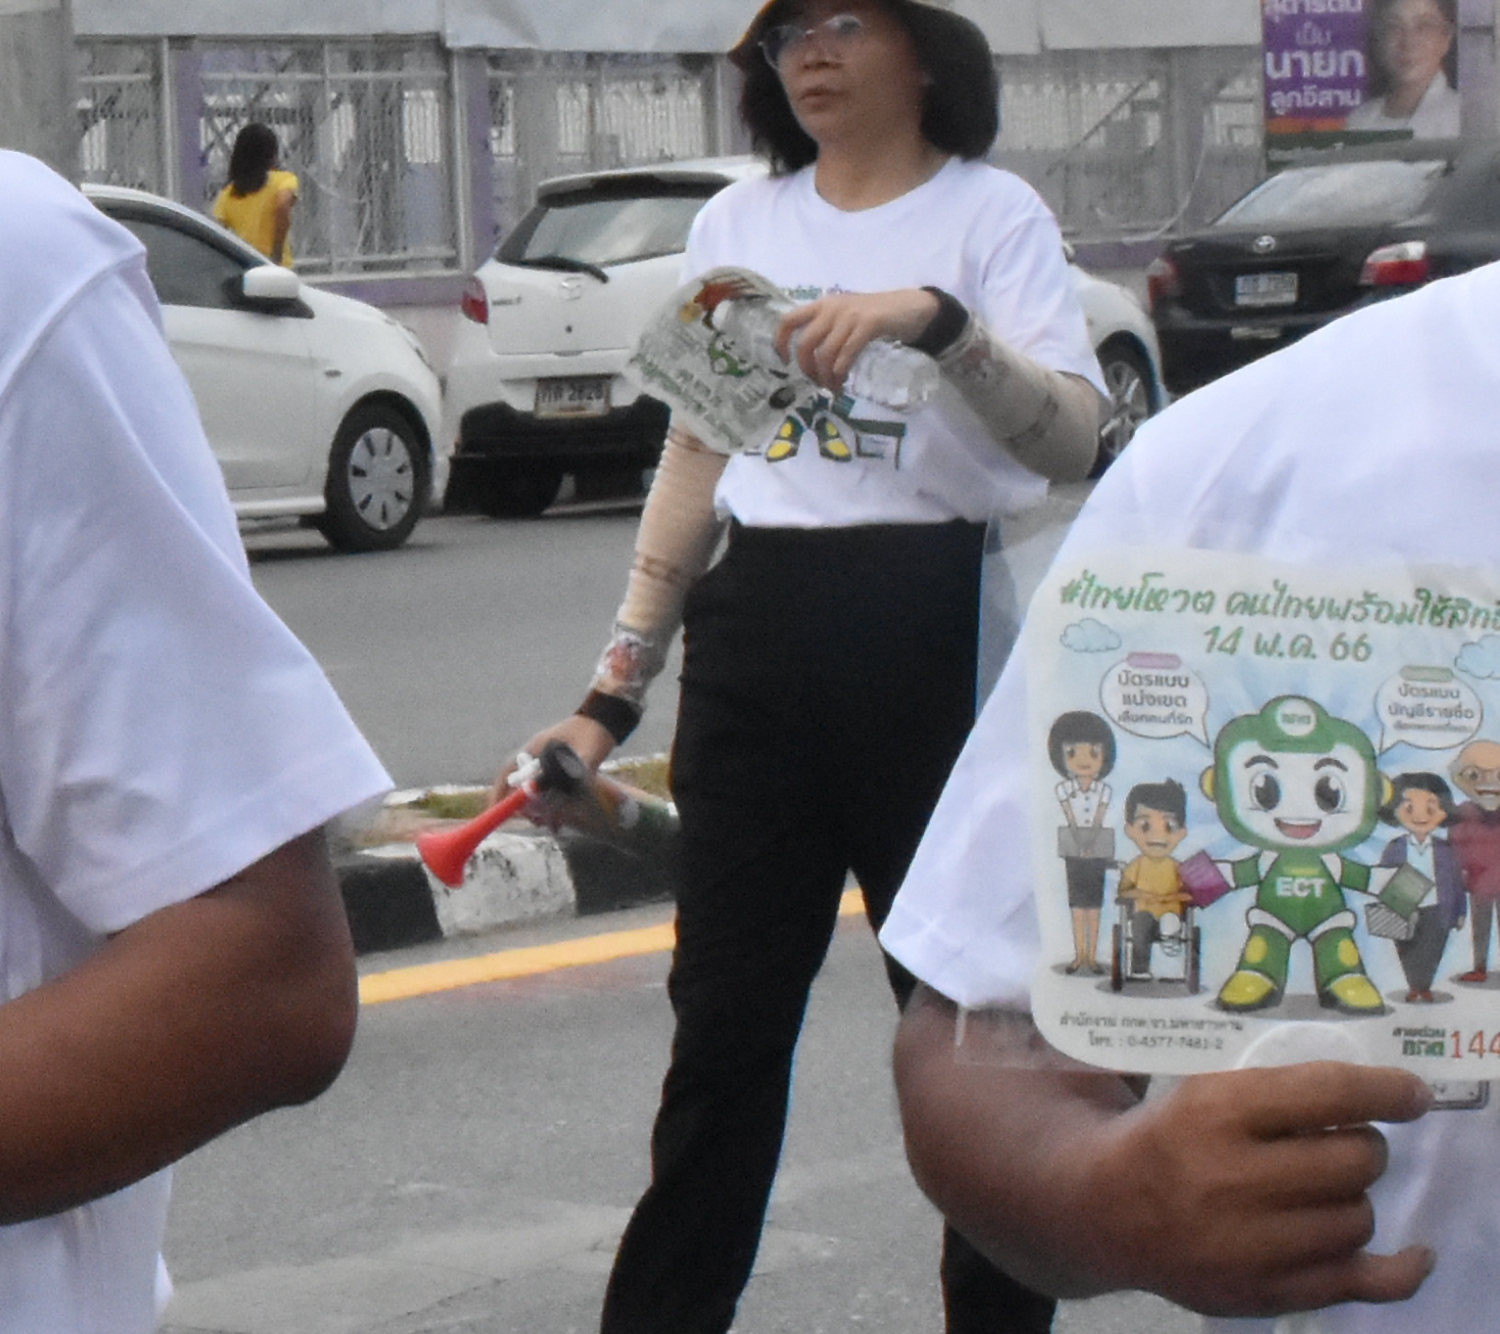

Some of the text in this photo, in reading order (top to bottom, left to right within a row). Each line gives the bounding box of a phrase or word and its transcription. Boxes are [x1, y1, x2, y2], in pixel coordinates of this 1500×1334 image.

[1265, 48, 1365, 79] นายก
[1203, 625, 1373, 663] 14 พ.ค. 66
[1117, 669, 1190, 689] บัตรแบบ
[1276, 877, 1327, 898] ECT
